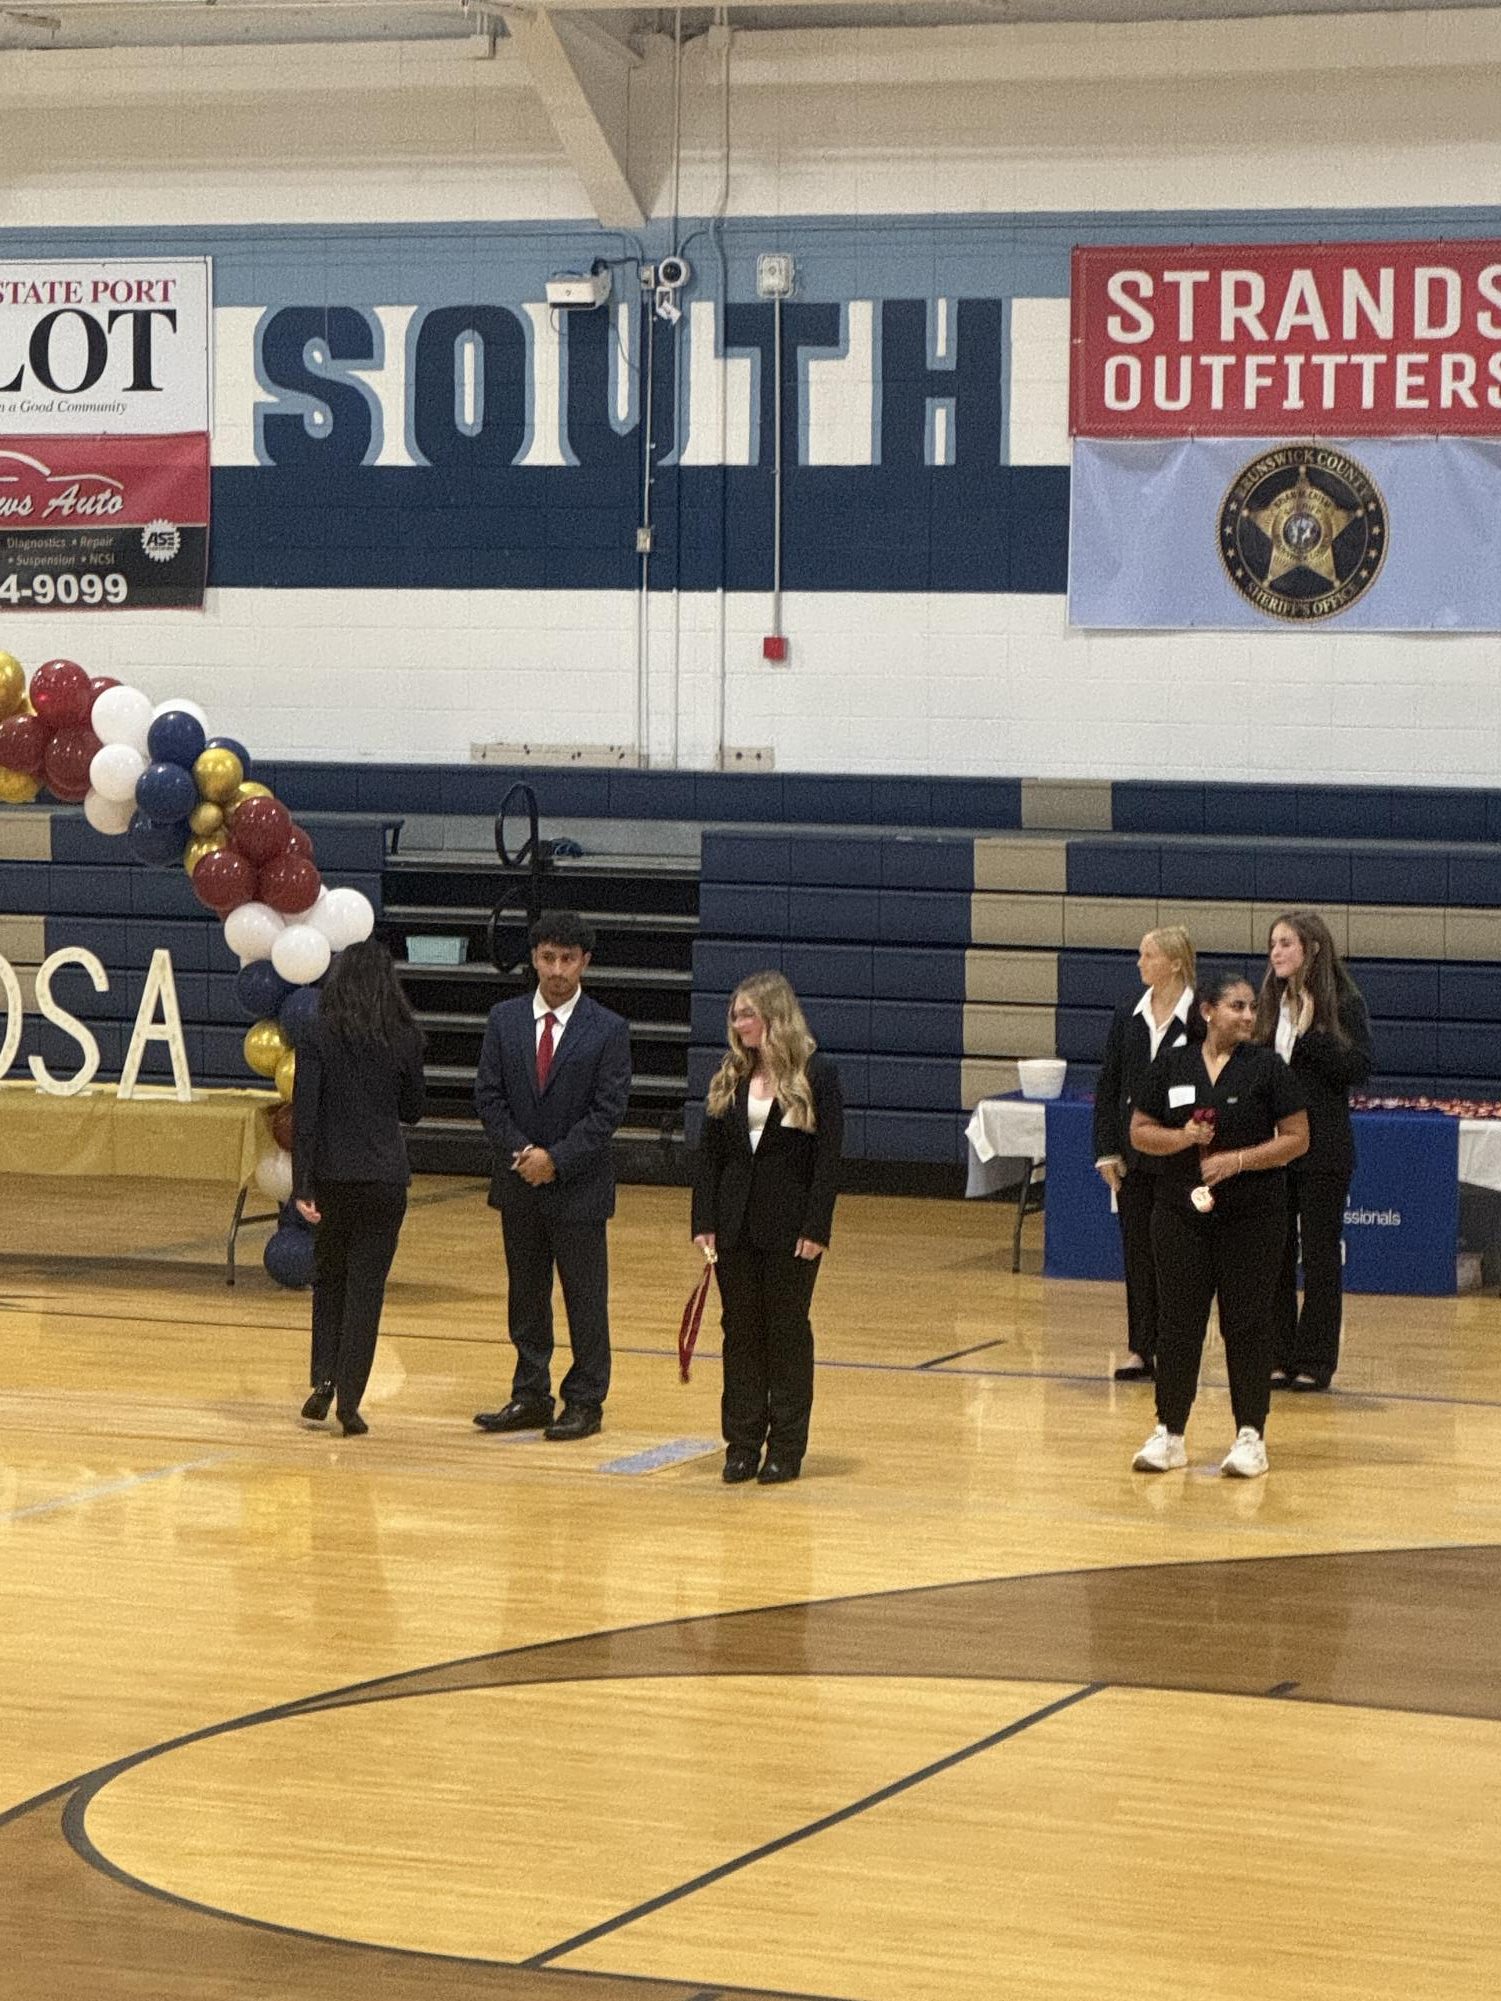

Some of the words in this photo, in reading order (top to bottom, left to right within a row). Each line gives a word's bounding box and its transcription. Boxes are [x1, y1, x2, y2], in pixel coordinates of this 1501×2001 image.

[91, 279, 176, 304] PORT
[253, 300, 1010, 467] SOUTH
[8, 403, 17, 412] a
[20, 400, 55, 413] Good
[57, 400, 128, 416] Community
[42, 484, 123, 517] Auto
[7, 536, 66, 551] Diagnostics
[80, 535, 114, 549] Repair
[147, 532, 175, 546] ASE
[15, 554, 76, 567] Suspension
[0, 573, 128, 604] 4-9099
